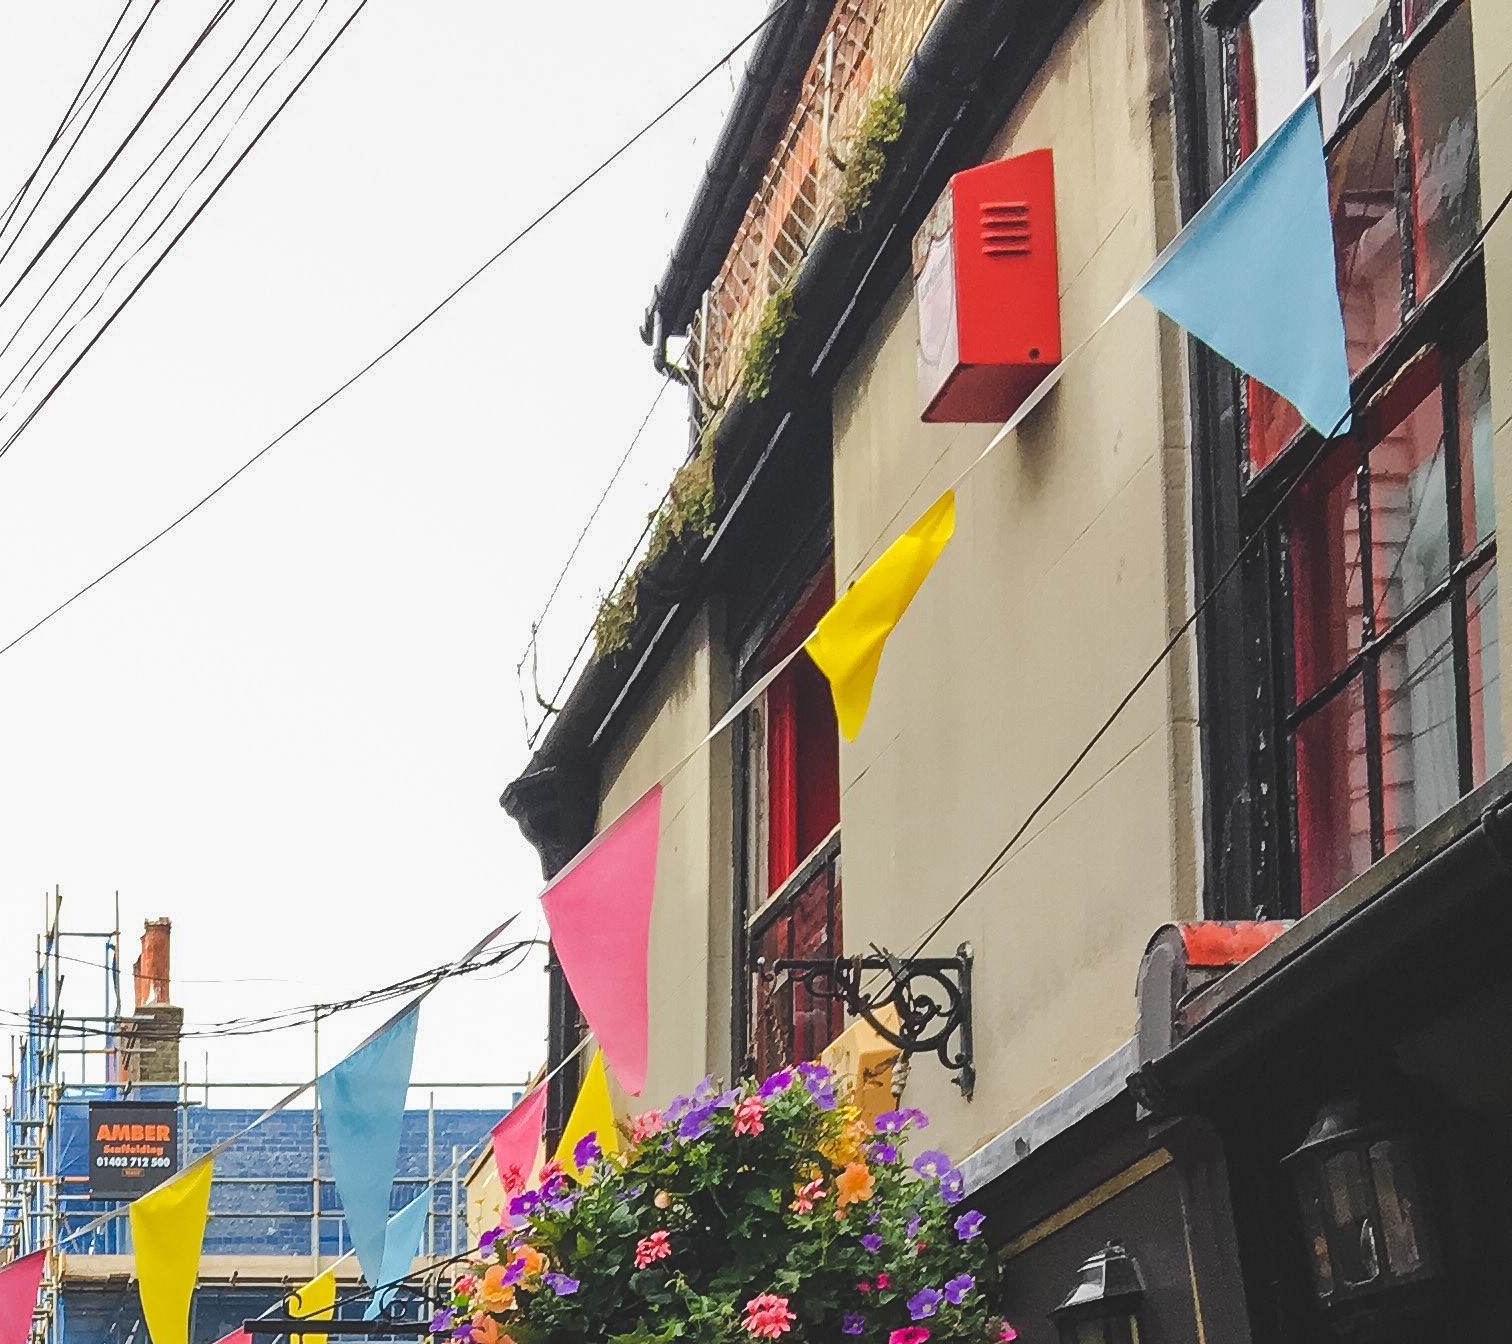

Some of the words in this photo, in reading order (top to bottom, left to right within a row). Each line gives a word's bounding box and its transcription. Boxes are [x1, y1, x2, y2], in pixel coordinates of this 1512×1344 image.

[96, 1124, 170, 1141] AMBER
[103, 1144, 164, 1156] Scaffolding
[96, 1157, 128, 1167] 01403
[129, 1157, 149, 1167] 712
[150, 1157, 171, 1167] 500
